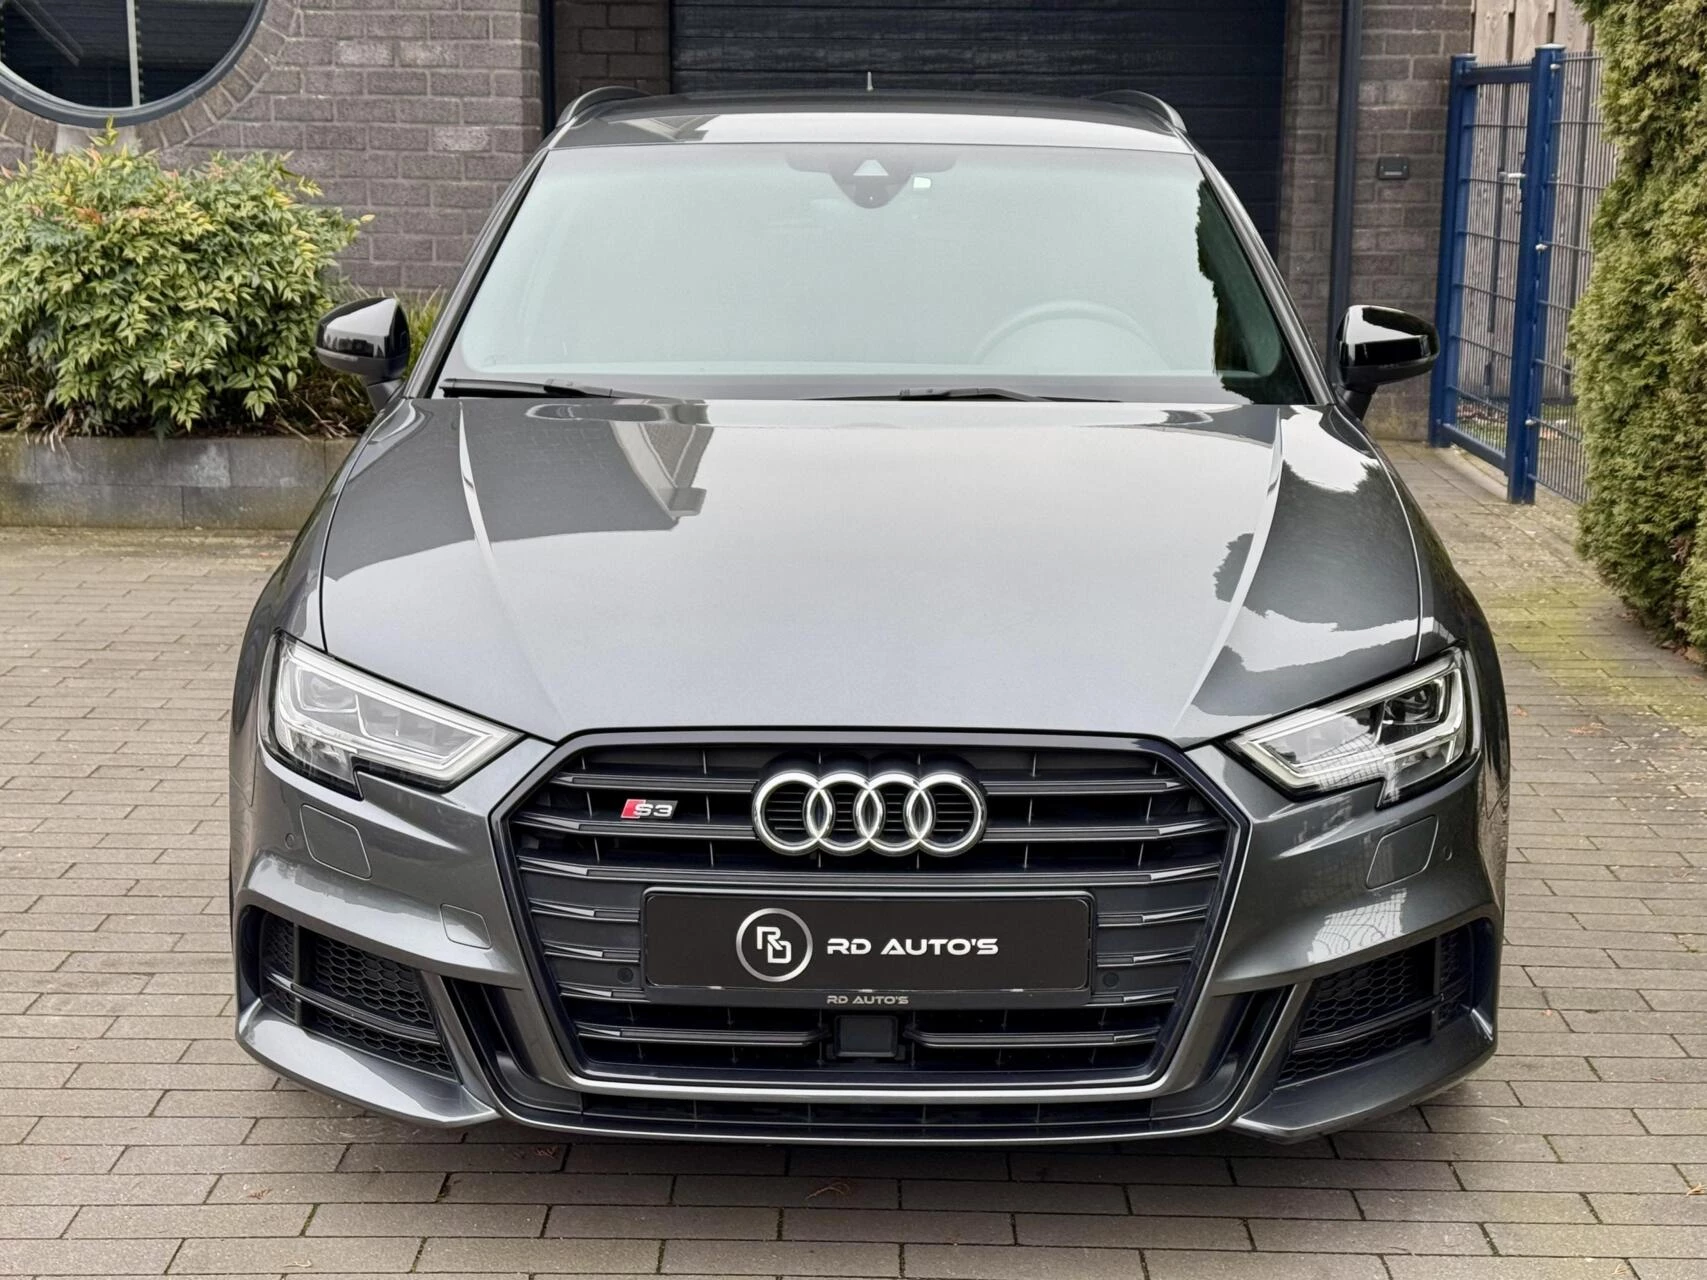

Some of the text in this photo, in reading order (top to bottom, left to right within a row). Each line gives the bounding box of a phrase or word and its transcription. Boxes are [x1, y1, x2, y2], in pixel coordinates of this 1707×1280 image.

[633, 803, 673, 817] S3
[826, 938, 999, 955] RD AUTO'S
[826, 995, 909, 1005] RD AUTO'S
